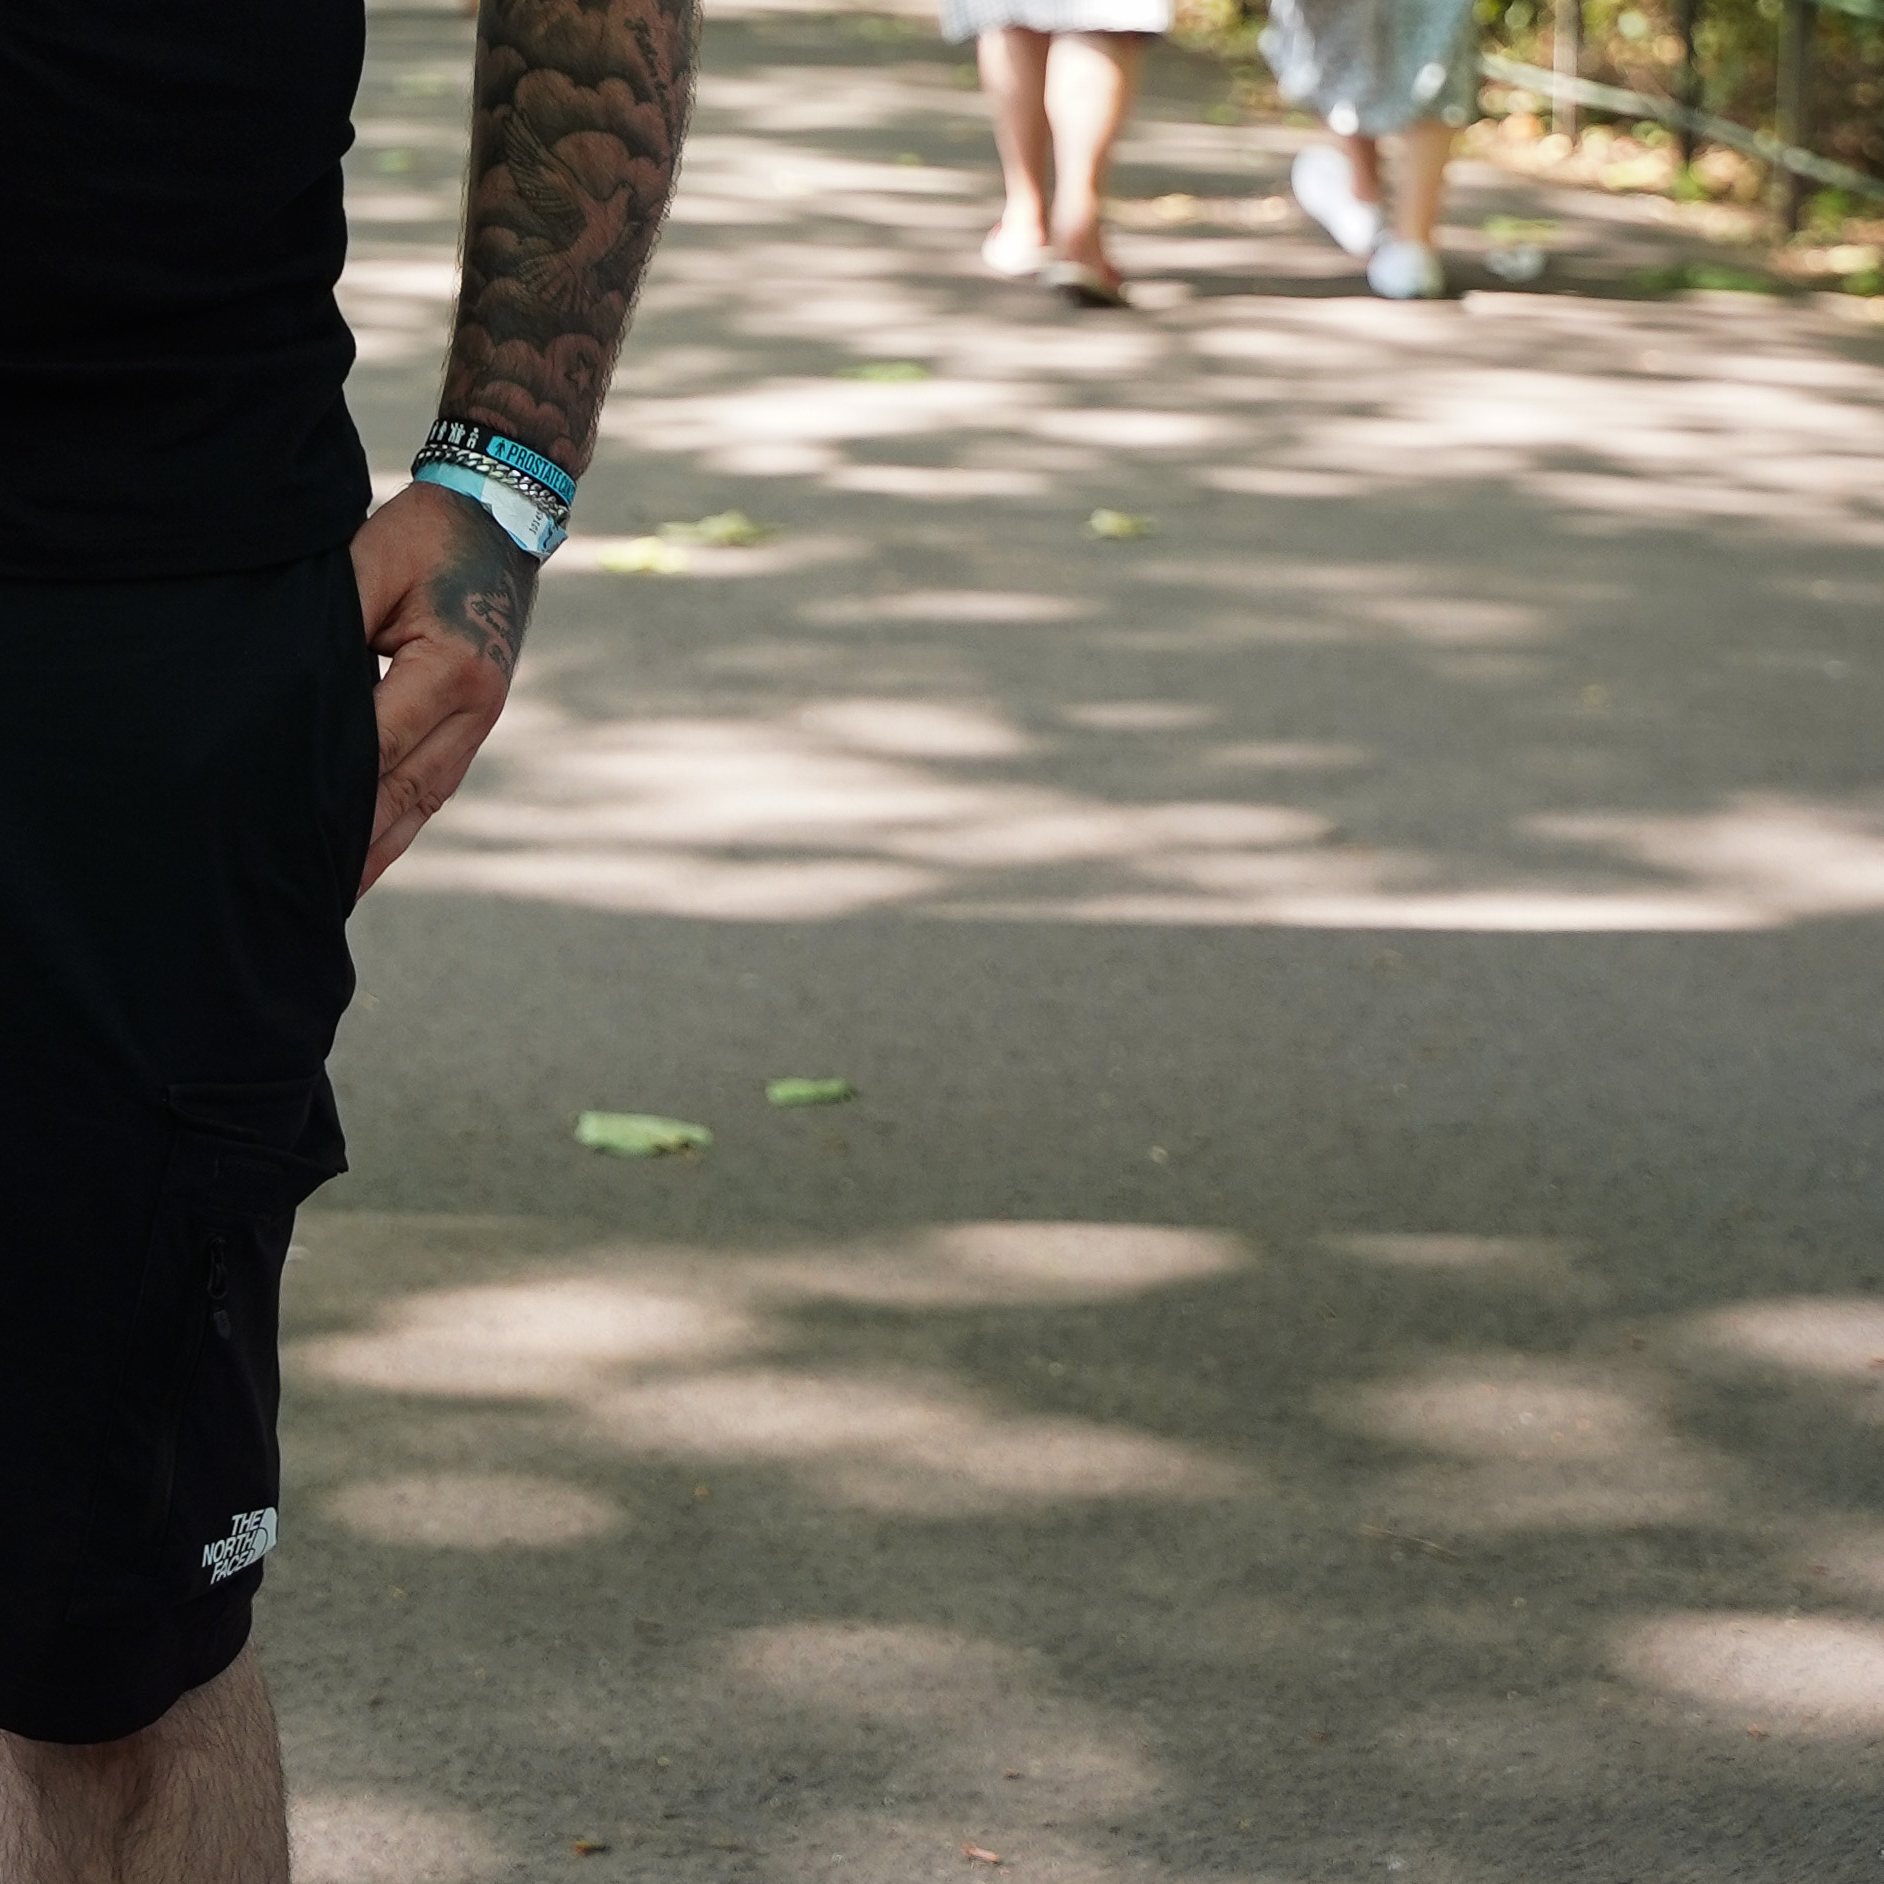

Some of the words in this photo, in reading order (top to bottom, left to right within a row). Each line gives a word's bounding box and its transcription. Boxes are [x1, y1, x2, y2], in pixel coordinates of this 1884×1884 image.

[506, 444, 562, 489] PROSTATE
[231, 1509, 265, 1536] THE
[202, 1531, 256, 1568] NORTH
[210, 1551, 250, 1585] FACE
